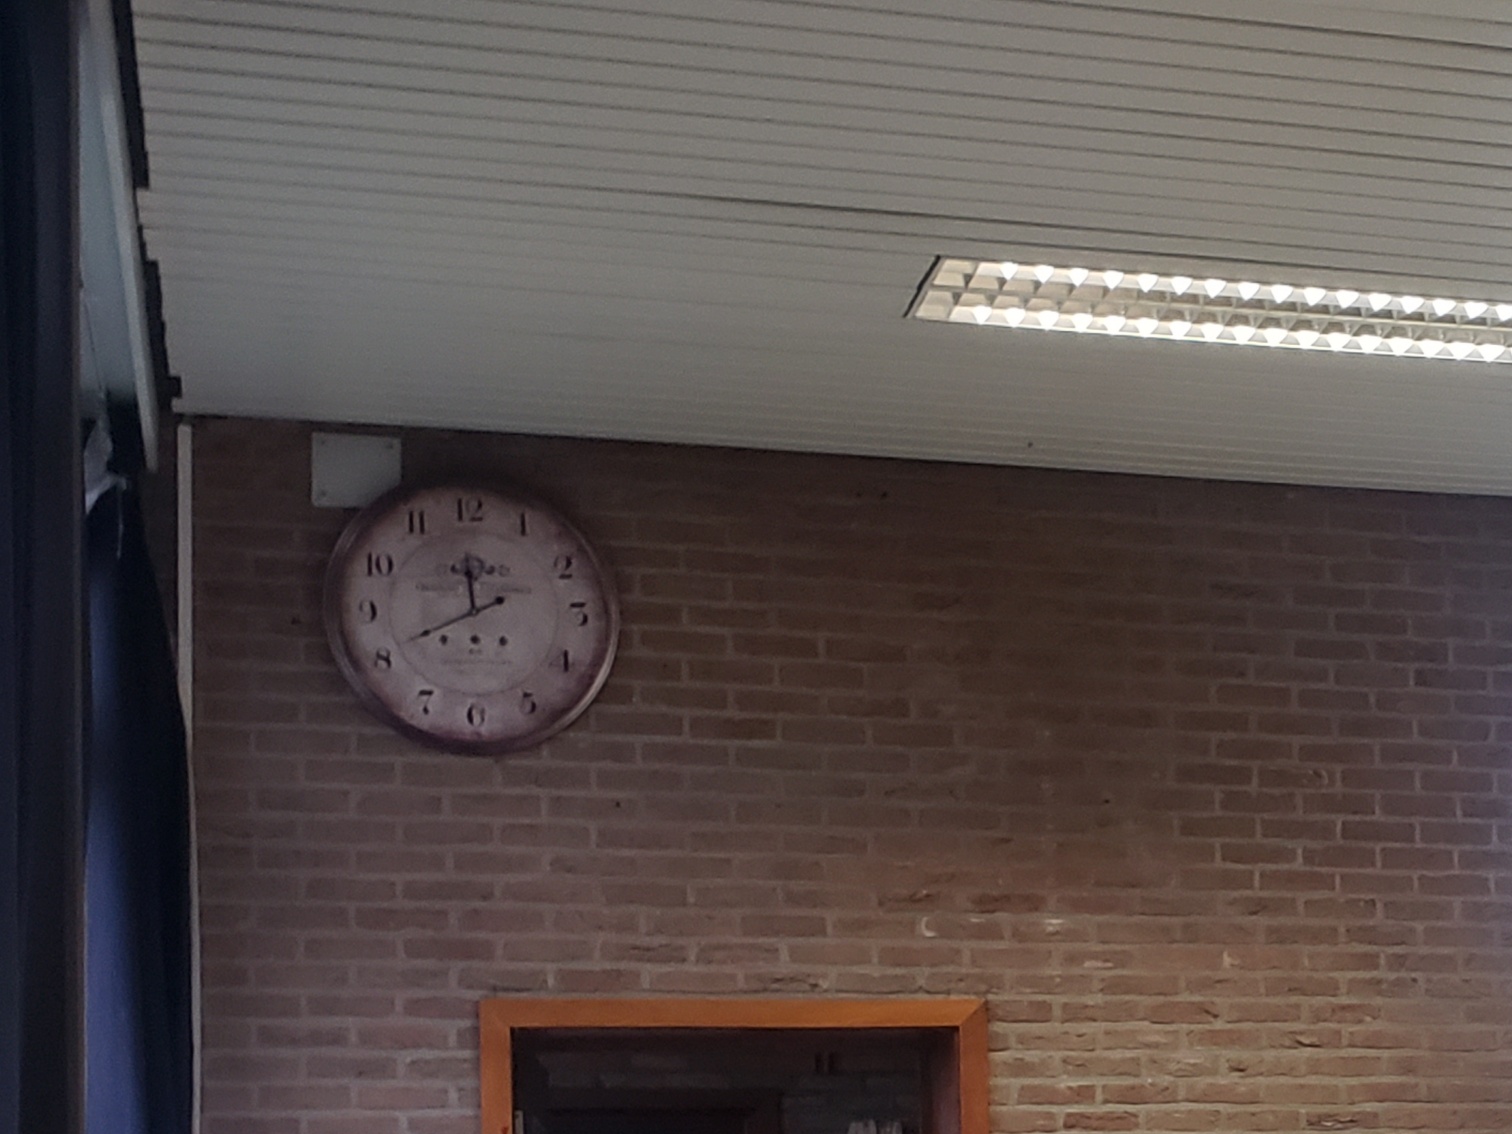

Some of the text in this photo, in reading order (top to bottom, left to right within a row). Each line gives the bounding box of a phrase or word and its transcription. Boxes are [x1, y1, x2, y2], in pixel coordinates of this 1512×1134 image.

[408, 510, 425, 535] 11
[457, 498, 483, 522] 12
[520, 511, 527, 537] 1
[367, 552, 394, 577] 10
[553, 554, 573, 580] 2
[359, 600, 378, 624] 9
[569, 601, 589, 627] 3
[374, 648, 392, 670] 8
[417, 689, 434, 715] 7
